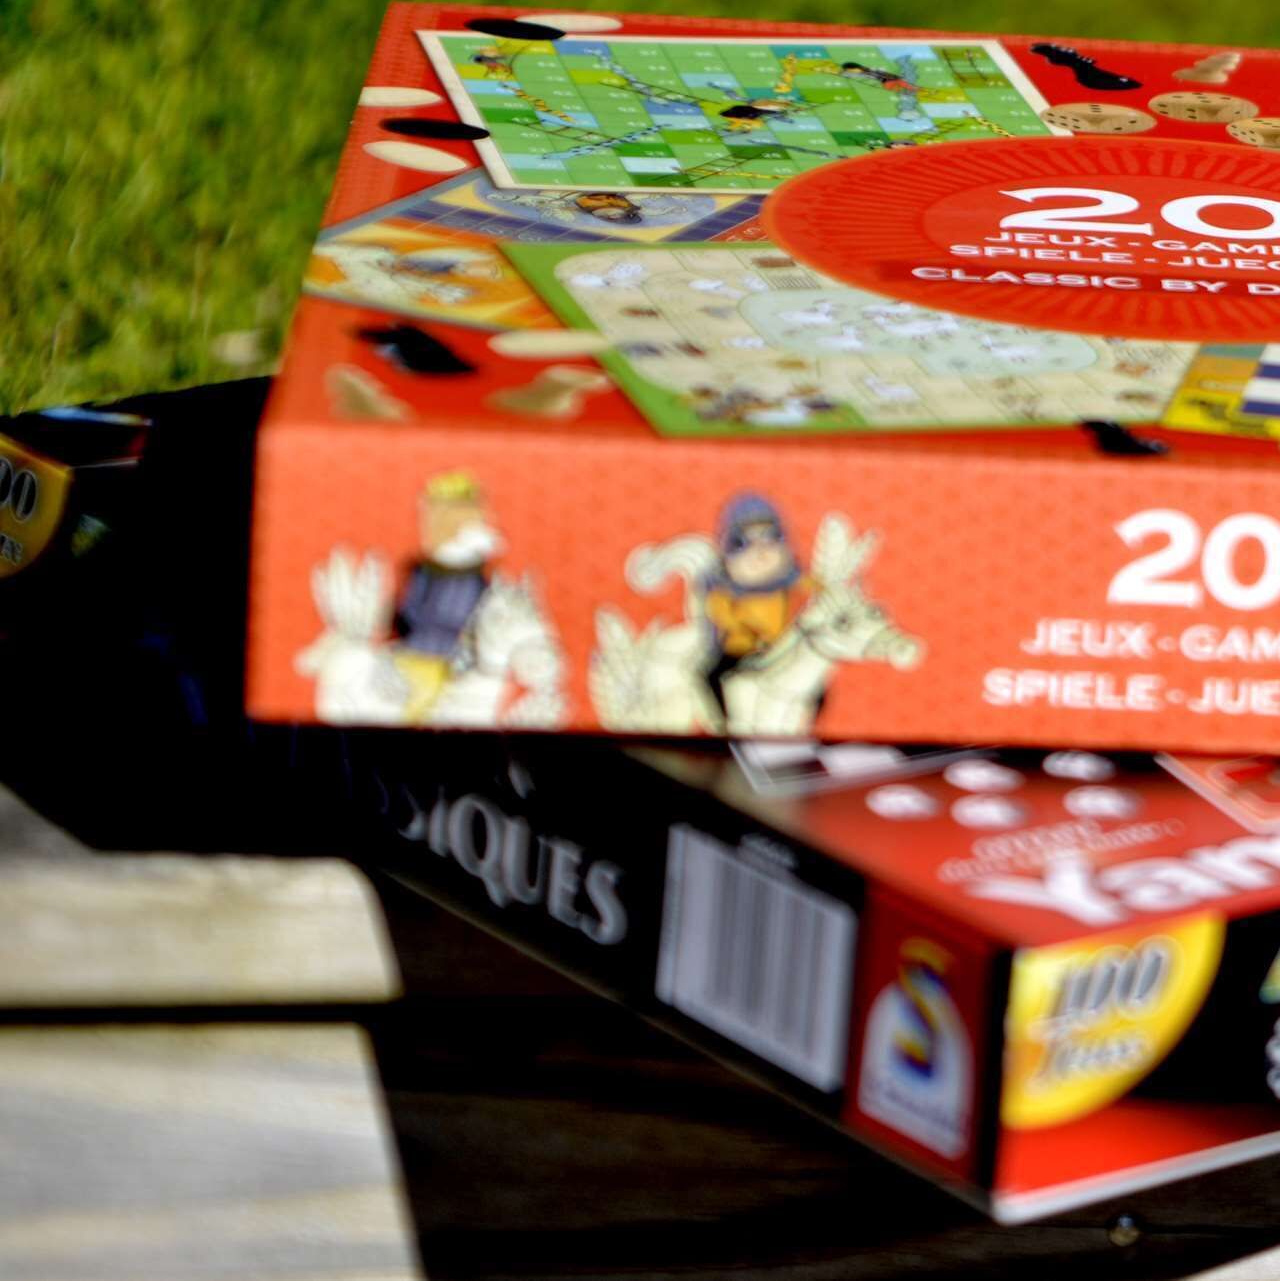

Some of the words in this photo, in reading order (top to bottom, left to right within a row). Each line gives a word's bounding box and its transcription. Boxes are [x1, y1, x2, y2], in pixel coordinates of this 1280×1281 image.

[949, 244, 1135, 264] SPIELE
[984, 232, 1117, 249] JEUX
[911, 266, 1143, 291] CLASSIC
[1160, 277, 1228, 294] BY
[1020, 617, 1157, 659] JEUX
[982, 667, 1166, 712] SPIELE
